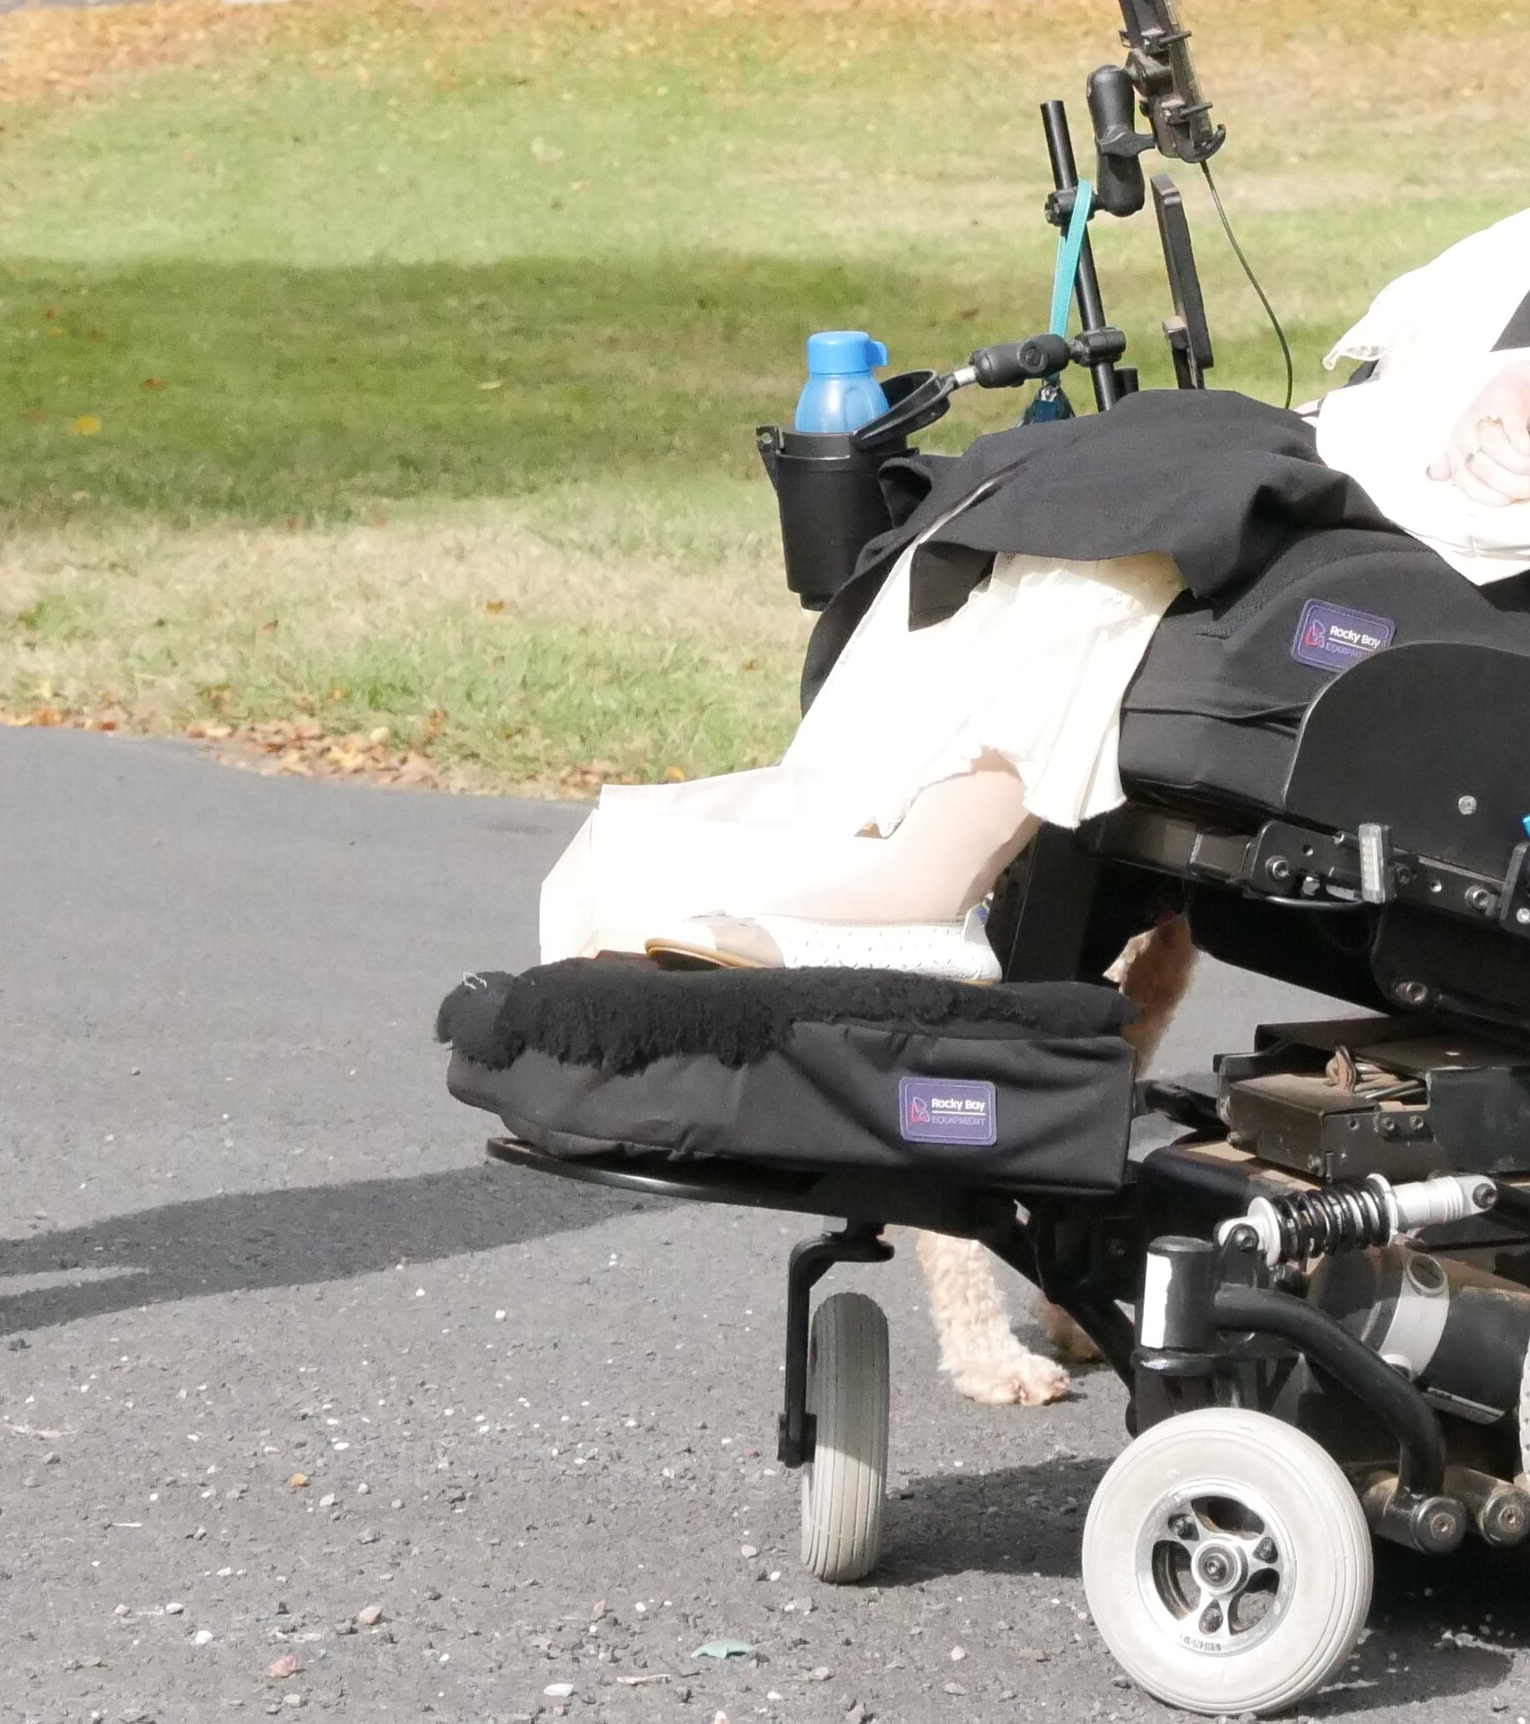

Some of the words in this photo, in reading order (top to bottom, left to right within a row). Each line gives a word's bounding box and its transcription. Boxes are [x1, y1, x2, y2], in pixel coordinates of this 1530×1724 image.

[1330, 625, 1361, 644] Rocky
[1361, 634, 1381, 649] Bay
[931, 1098, 963, 1111] Rocky
[964, 1099, 986, 1112] Bay
[931, 1115, 986, 1126] EQUIPMENT
